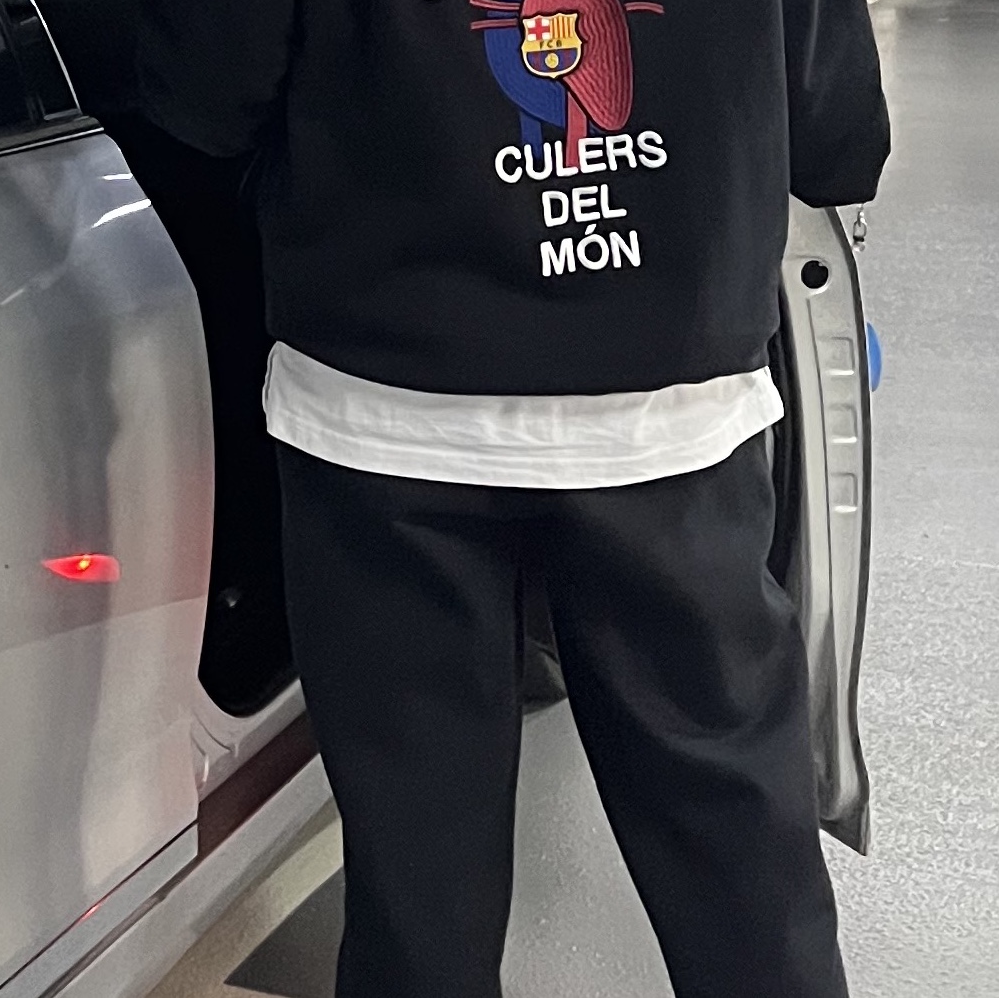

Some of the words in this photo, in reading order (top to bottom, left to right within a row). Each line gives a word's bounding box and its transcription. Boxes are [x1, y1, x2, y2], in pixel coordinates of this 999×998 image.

[494, 130, 668, 184] CULERS
[541, 183, 628, 228] DEL
[539, 223, 642, 278] MÓN
